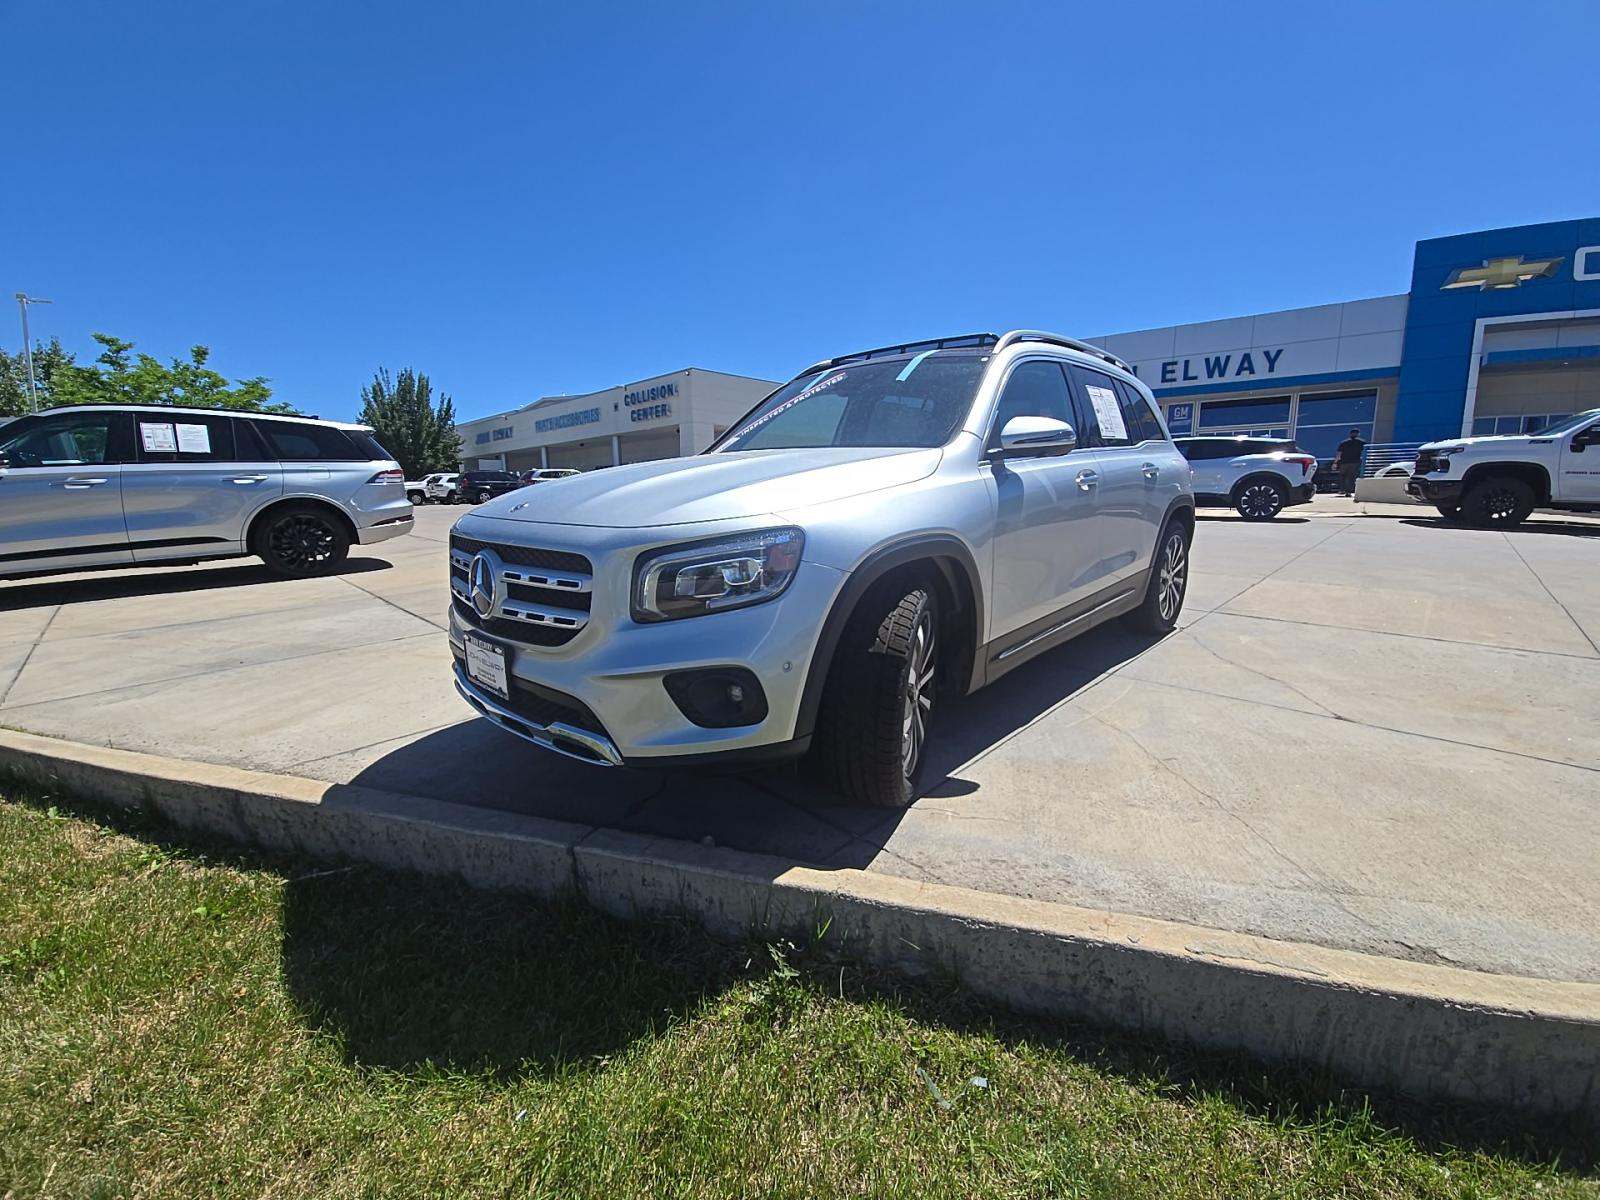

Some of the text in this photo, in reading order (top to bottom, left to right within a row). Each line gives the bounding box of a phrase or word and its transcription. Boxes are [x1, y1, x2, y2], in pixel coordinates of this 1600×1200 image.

[1160, 348, 1284, 384] ELWAY
[624, 383, 674, 407] COLLISION
[793, 375, 844, 402] PROTECTED
[630, 403, 667, 422] CENTER
[1174, 406, 1189, 418] GM
